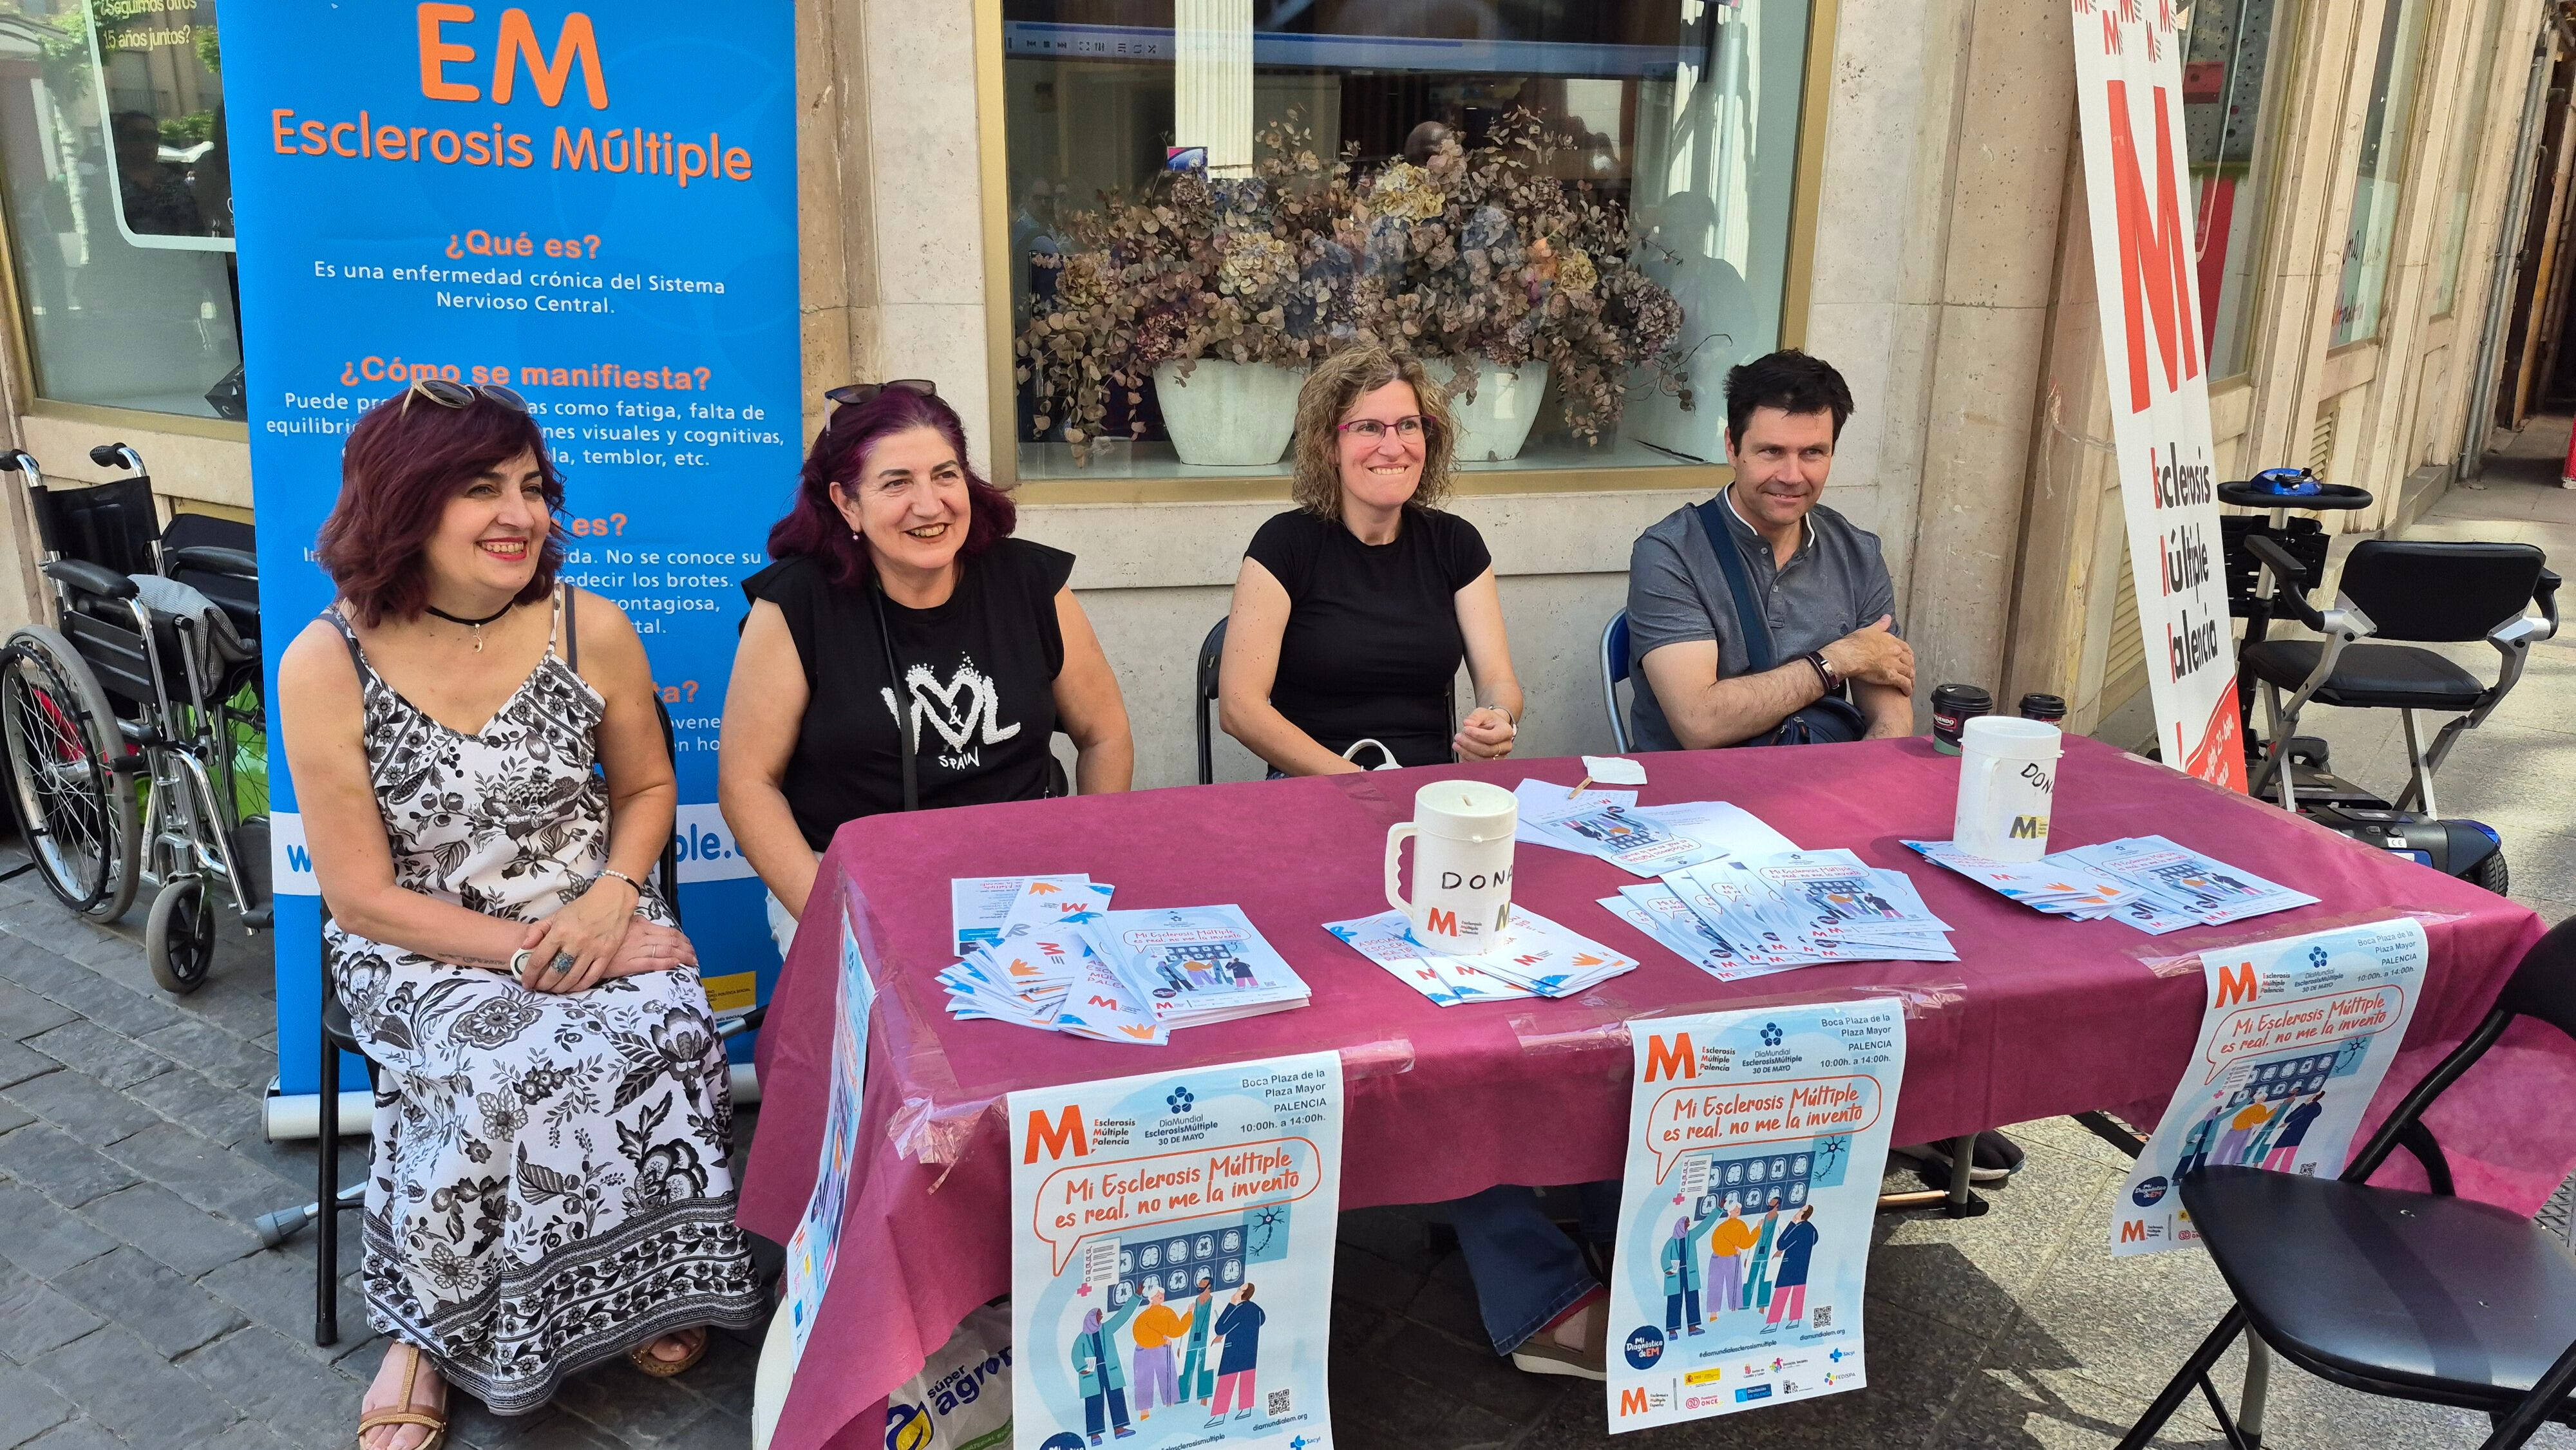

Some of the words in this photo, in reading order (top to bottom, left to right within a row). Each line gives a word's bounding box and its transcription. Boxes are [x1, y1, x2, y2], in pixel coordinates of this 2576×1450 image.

[103, 30, 117, 50] 15
[118, 28, 147, 47] años
[149, 25, 190, 51] juntos?
[417, 3, 609, 110] EM
[272, 109, 534, 169] Esclerosis
[553, 126, 753, 187] Múltiple
[446, 230, 534, 259] ¿Qué
[545, 235, 601, 259] es?
[2107, 80, 2199, 413] M
[315, 261, 336, 278] Es
[345, 264, 384, 280] una
[393, 264, 522, 287] enfermedad
[530, 271, 603, 290] crónica
[611, 273, 641, 292] del
[650, 276, 725, 294] Sistema
[437, 290, 528, 310] Nervioso
[535, 294, 616, 315] Central.
[341, 356, 460, 386] ¿Cómo
[472, 364, 509, 384] se
[521, 359, 712, 390] manifiesta?
[285, 393, 348, 410] Puede
[554, 402, 609, 415] como
[616, 400, 681, 421] fatiga,
[690, 402, 735, 420] falta
[743, 405, 764, 420] de
[583, 425, 659, 441] visuales
[667, 429, 677, 445] y
[685, 428, 784, 446] cognitivas,
[583, 449, 666, 467] temblor,
[675, 452, 710, 466] etc.
[573, 513, 628, 536] es?
[607, 550, 633, 564] No
[641, 552, 659, 564] se
[667, 552, 735, 564] conoce
[742, 552, 761, 564] su
[556, 572, 625, 587] redecir
[633, 572, 659, 587] los
[667, 572, 734, 587] brotes.
[939, 747, 980, 770] SPAIN
[2020, 763, 2054, 794] DON
[2009, 816, 2036, 839] M
[1428, 907, 1457, 936] M
[2358, 939, 2376, 947] Boca
[2377, 934, 2396, 945] Plaza
[2375, 945, 2394, 954] Plaza
[2396, 941, 2416, 952] Mayor
[2382, 954, 2417, 966] PALENCIA
[2214, 962, 2257, 1009] M
[1088, 995, 1117, 1011] M
[1821, 1019, 1844, 1027] Boca
[1846, 1017, 1868, 1025] Plaza
[1882, 1013, 1890, 1022] la
[2232, 1018, 2253, 1037] Mi
[2258, 1009, 2324, 1031] Esclerosis
[2329, 993, 2385, 1019] Múltiple
[1842, 1028, 1864, 1037] Plaza
[1867, 1026, 1891, 1036] Mayor
[2220, 1041, 2236, 1054] es
[2276, 1031, 2291, 1042] no
[2296, 1028, 2318, 1040] me
[2321, 1018, 2333, 1035] la
[2338, 1010, 2386, 1031] invento
[1755, 1049, 1790, 1057] DíaMundial
[1848, 1040, 1892, 1050] PALENCIA
[1643, 1032, 1696, 1082] M
[1701, 1055, 1730, 1064] Múltiple
[1742, 1055, 1802, 1067] EsclerosisMúltiple
[1242, 1077, 1268, 1088] Boca
[1271, 1073, 1302, 1085] Plaza
[1302, 1072, 1314, 1081] de
[1316, 1069, 1325, 1078] la
[1265, 1087, 1293, 1098] Plaza
[1296, 1082, 1326, 1095] Mayor
[1274, 1097, 1327, 1113] PALENCIA
[1673, 1098, 1696, 1120] Mi
[1703, 1094, 1784, 1117] Esclerosis
[1790, 1082, 1859, 1109] Múltiple
[1145, 1121, 1218, 1138] EsclerosisMúltiple
[1160, 1115, 1203, 1126] DíaMundial
[1663, 1127, 1680, 1142] es
[1730, 1118, 1749, 1133] no
[1755, 1116, 1781, 1132] me
[1786, 1109, 1800, 1129] la
[1806, 1104, 1862, 1127] invento
[1024, 1104, 1089, 1165] M
[1092, 1137, 1130, 1145] Palencia
[1094, 1127, 1129, 1138] Múltiple
[1183, 1133, 1204, 1143] MAYO
[1065, 1178, 1094, 1205] Mi
[1103, 1166, 1200, 1198] Esclerosis
[1209, 1147, 1293, 1180] Múltiple
[1056, 1210, 1076, 1229] es
[1138, 1198, 1160, 1215] no
[1170, 1192, 1200, 1212] me
[1206, 1178, 1224, 1203] la
[1231, 1170, 1300, 1199] invento
[2121, 1219, 2145, 1243] M
[1626, 1340, 1663, 1351] Diagnóstico
[1646, 1347, 1659, 1357] EM
[927, 1365, 965, 1398] súper
[935, 1346, 1012, 1415] agrop
[1620, 1387, 1648, 1417] M
[1253, 1413, 1307, 1432] diamundialem.org
